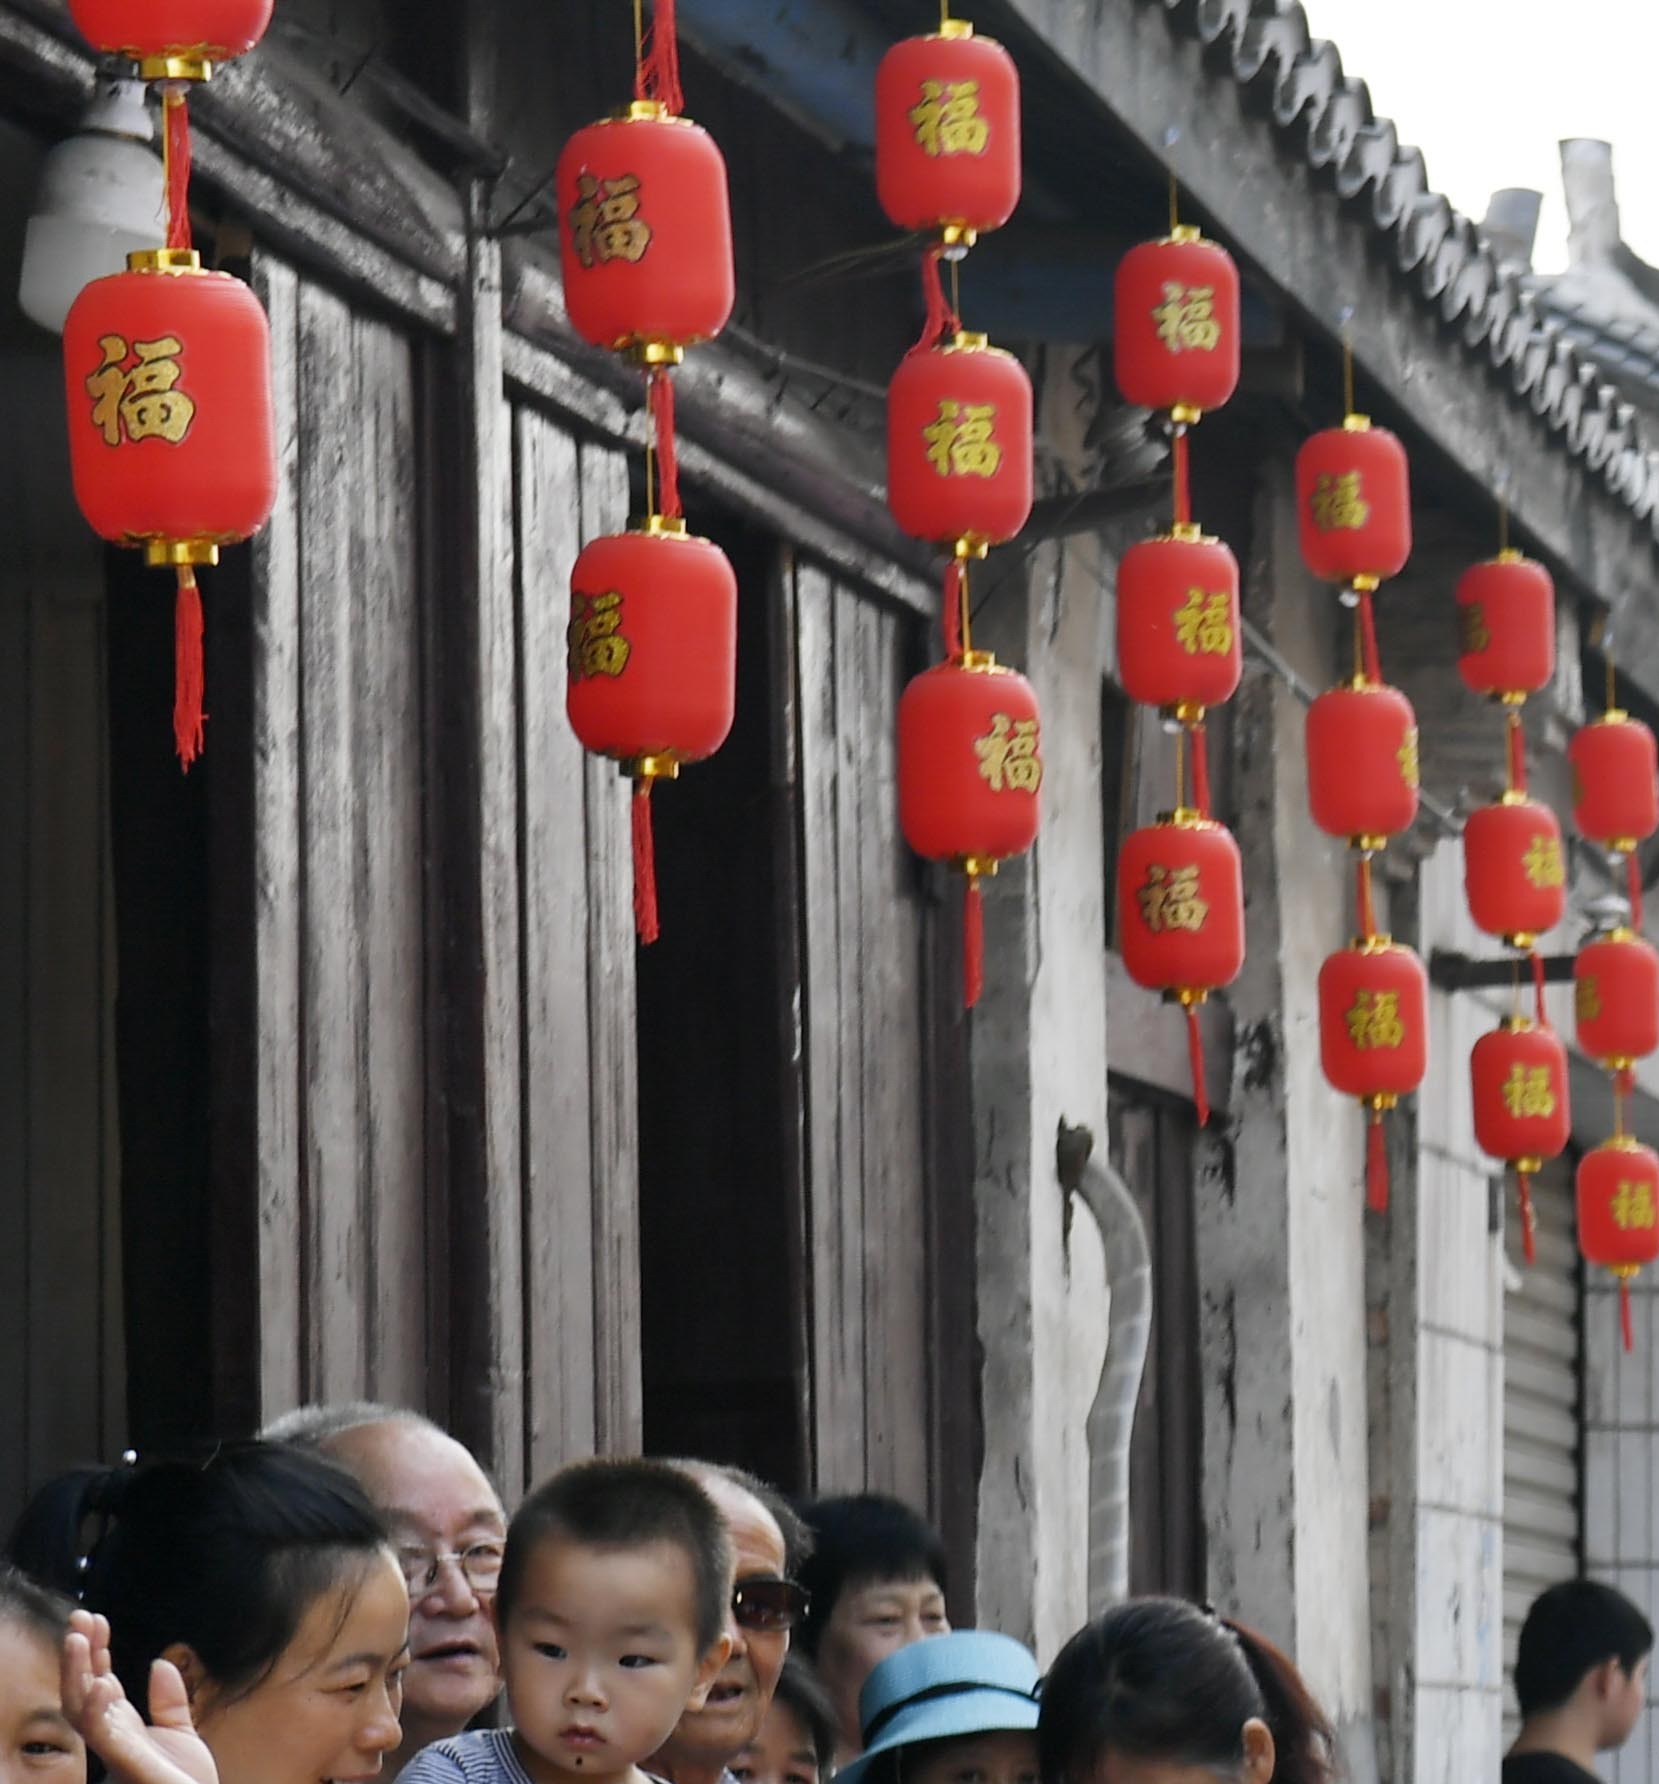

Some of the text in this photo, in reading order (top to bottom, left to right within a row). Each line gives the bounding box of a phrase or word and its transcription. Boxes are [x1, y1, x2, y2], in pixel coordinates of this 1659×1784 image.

[909, 79, 990, 157] 福
[568, 172, 653, 269] 福
[1151, 281, 1222, 353] 福
[85, 333, 195, 447] 福
[923, 399, 1003, 479] 福
[1310, 470, 1370, 530] 福
[567, 590, 632, 682] 福
[1173, 586, 1235, 656] 福
[974, 712, 1043, 794] 福
[1522, 835, 1565, 888] 福
[1136, 862, 1208, 933] 福
[1345, 988, 1405, 1050] 福
[1503, 1063, 1556, 1119] 福
[1610, 1180, 1655, 1230] 福
